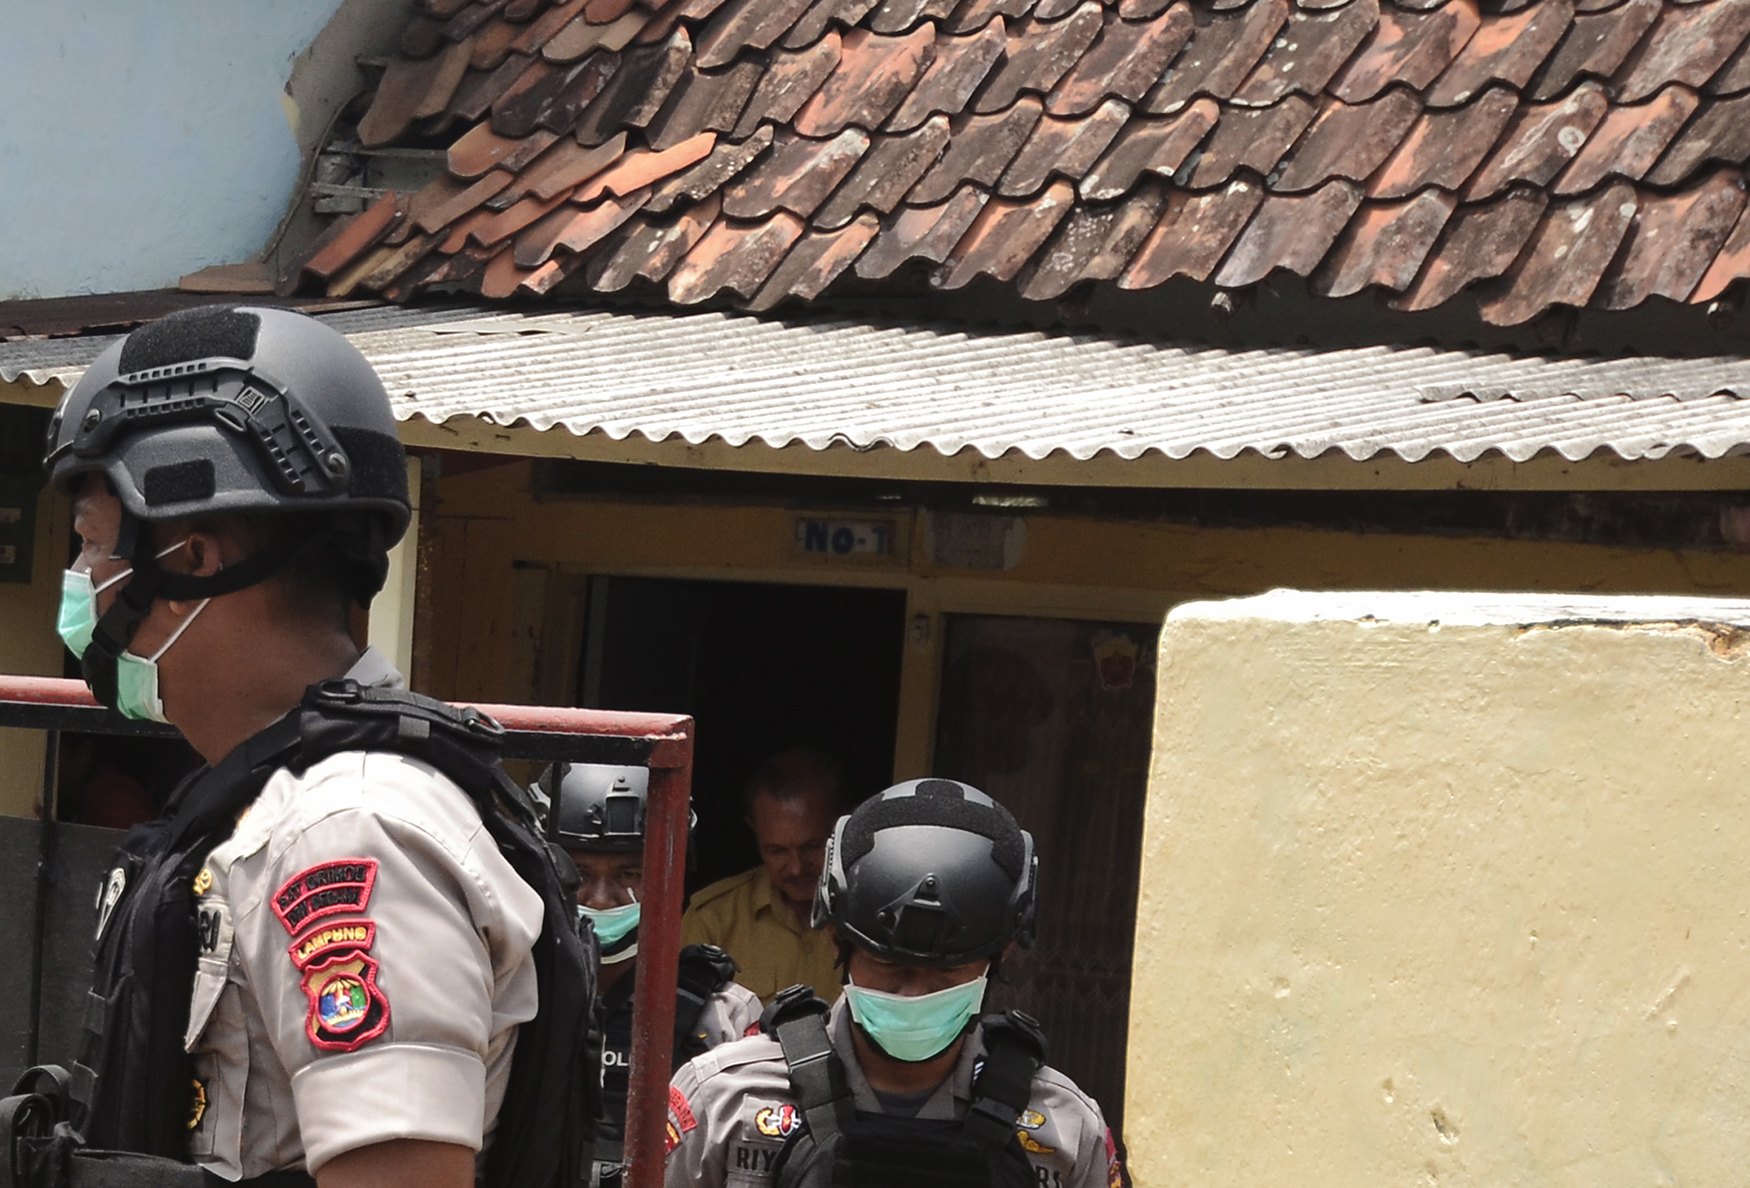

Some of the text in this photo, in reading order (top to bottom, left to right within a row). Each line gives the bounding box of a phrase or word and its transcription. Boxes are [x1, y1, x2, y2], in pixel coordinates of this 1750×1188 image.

[296, 926, 367, 960] LAMPUNG
[602, 1050, 629, 1067] OL
[736, 1146, 778, 1173] RIY
